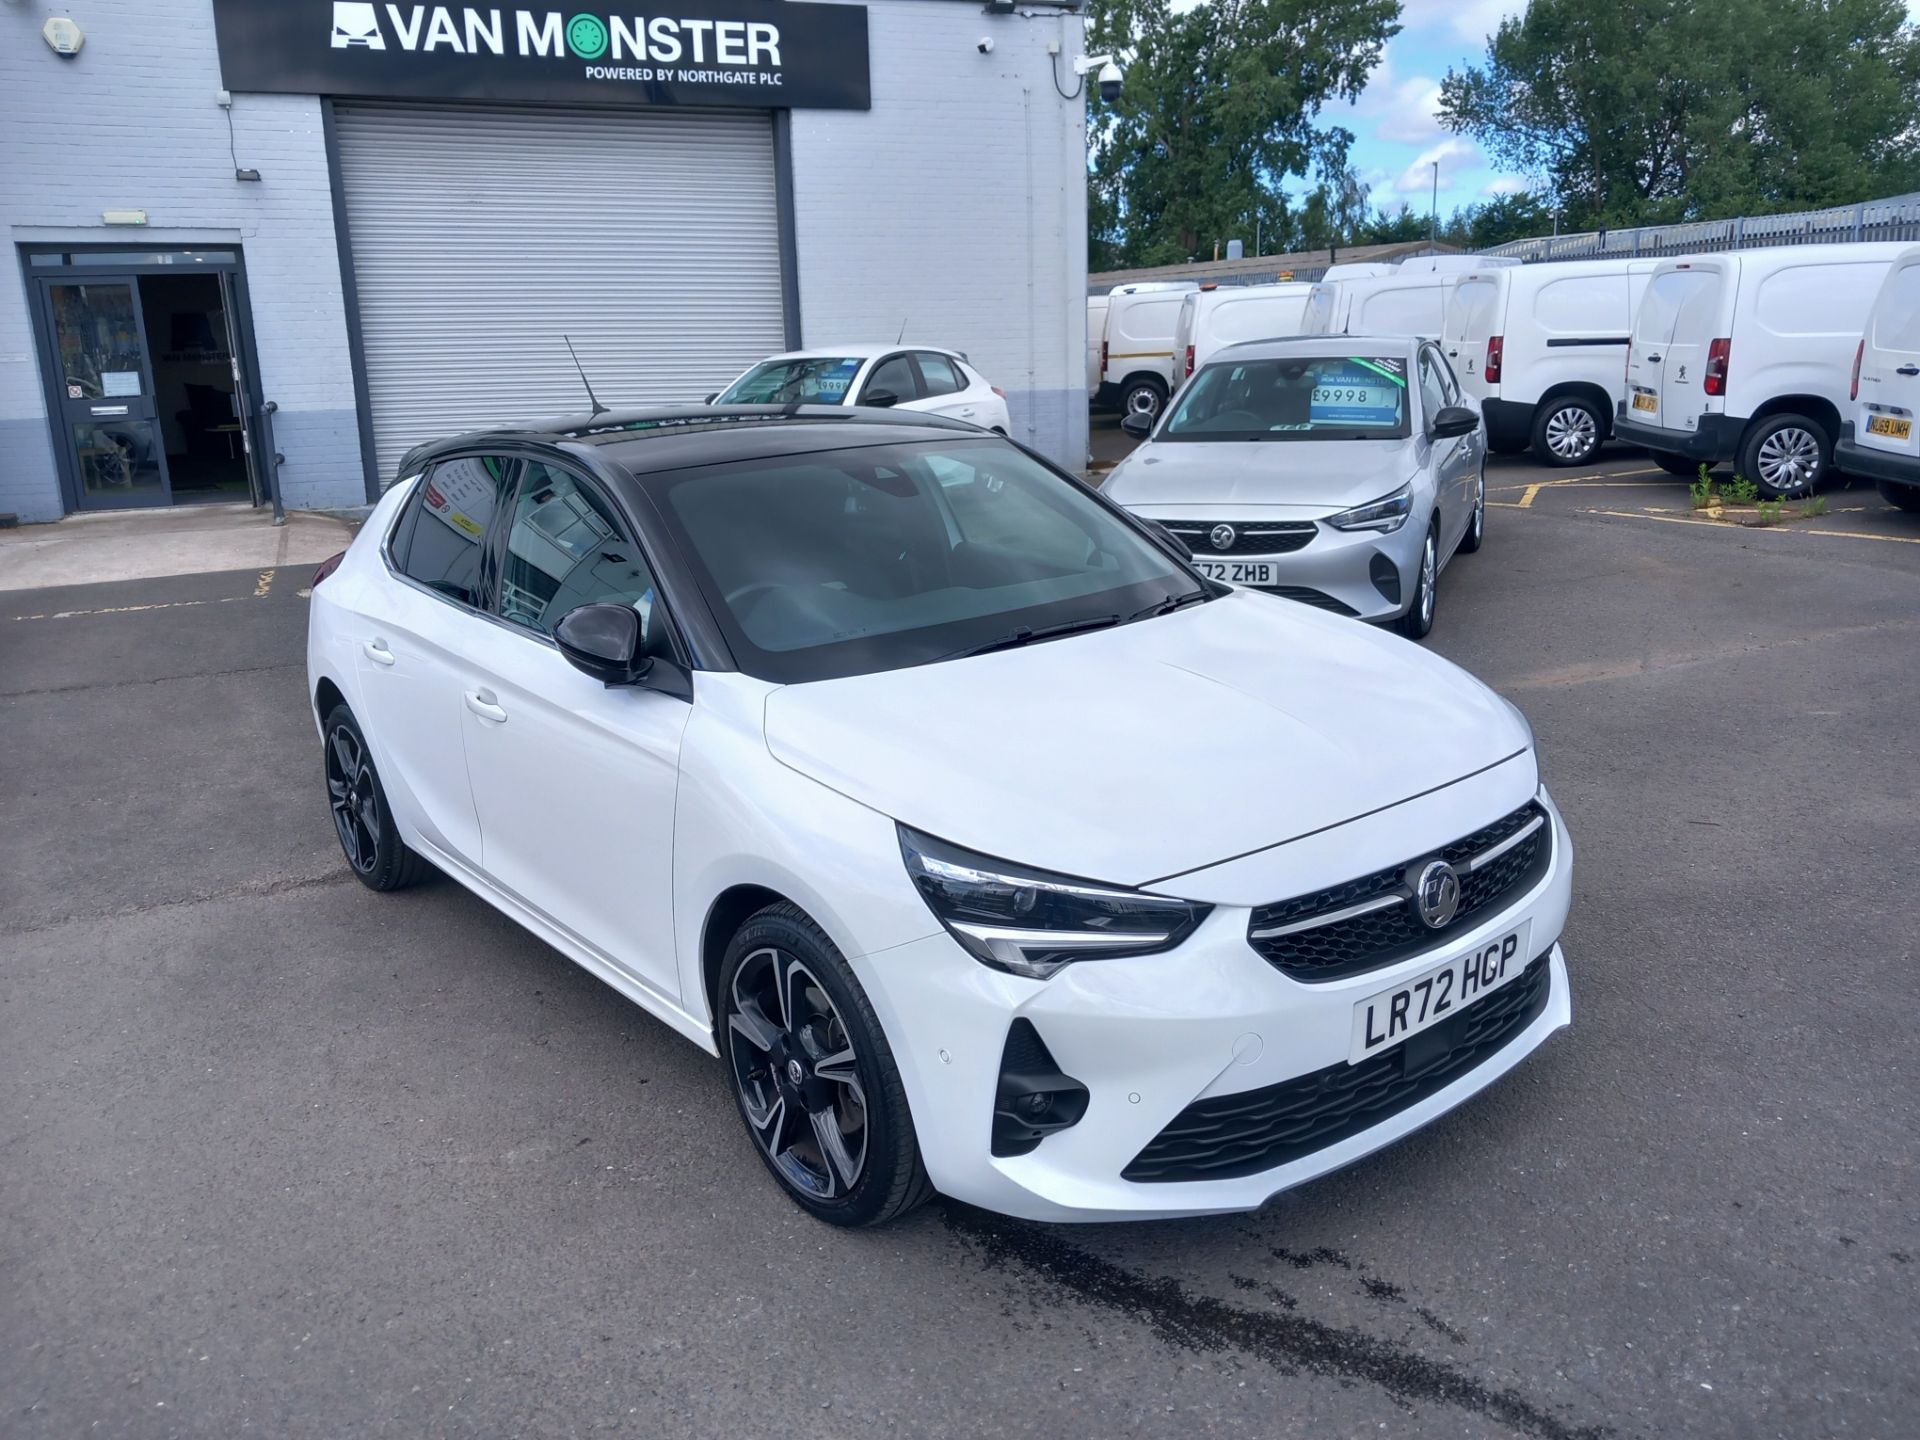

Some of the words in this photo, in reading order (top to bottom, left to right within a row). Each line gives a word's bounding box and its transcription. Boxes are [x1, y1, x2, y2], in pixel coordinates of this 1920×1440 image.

[385, 3, 504, 55] VAN
[515, 10, 782, 66] MONSTER
[586, 66, 653, 81] POWERED
[656, 69, 674, 82] BY
[678, 70, 756, 85] NORTHGATE
[759, 73, 783, 86] PLC
[1312, 389, 1367, 403] £9998
[1231, 564, 1270, 582] ZHB
[1365, 968, 1454, 1050] LR72
[1461, 933, 1518, 1000] HGP
